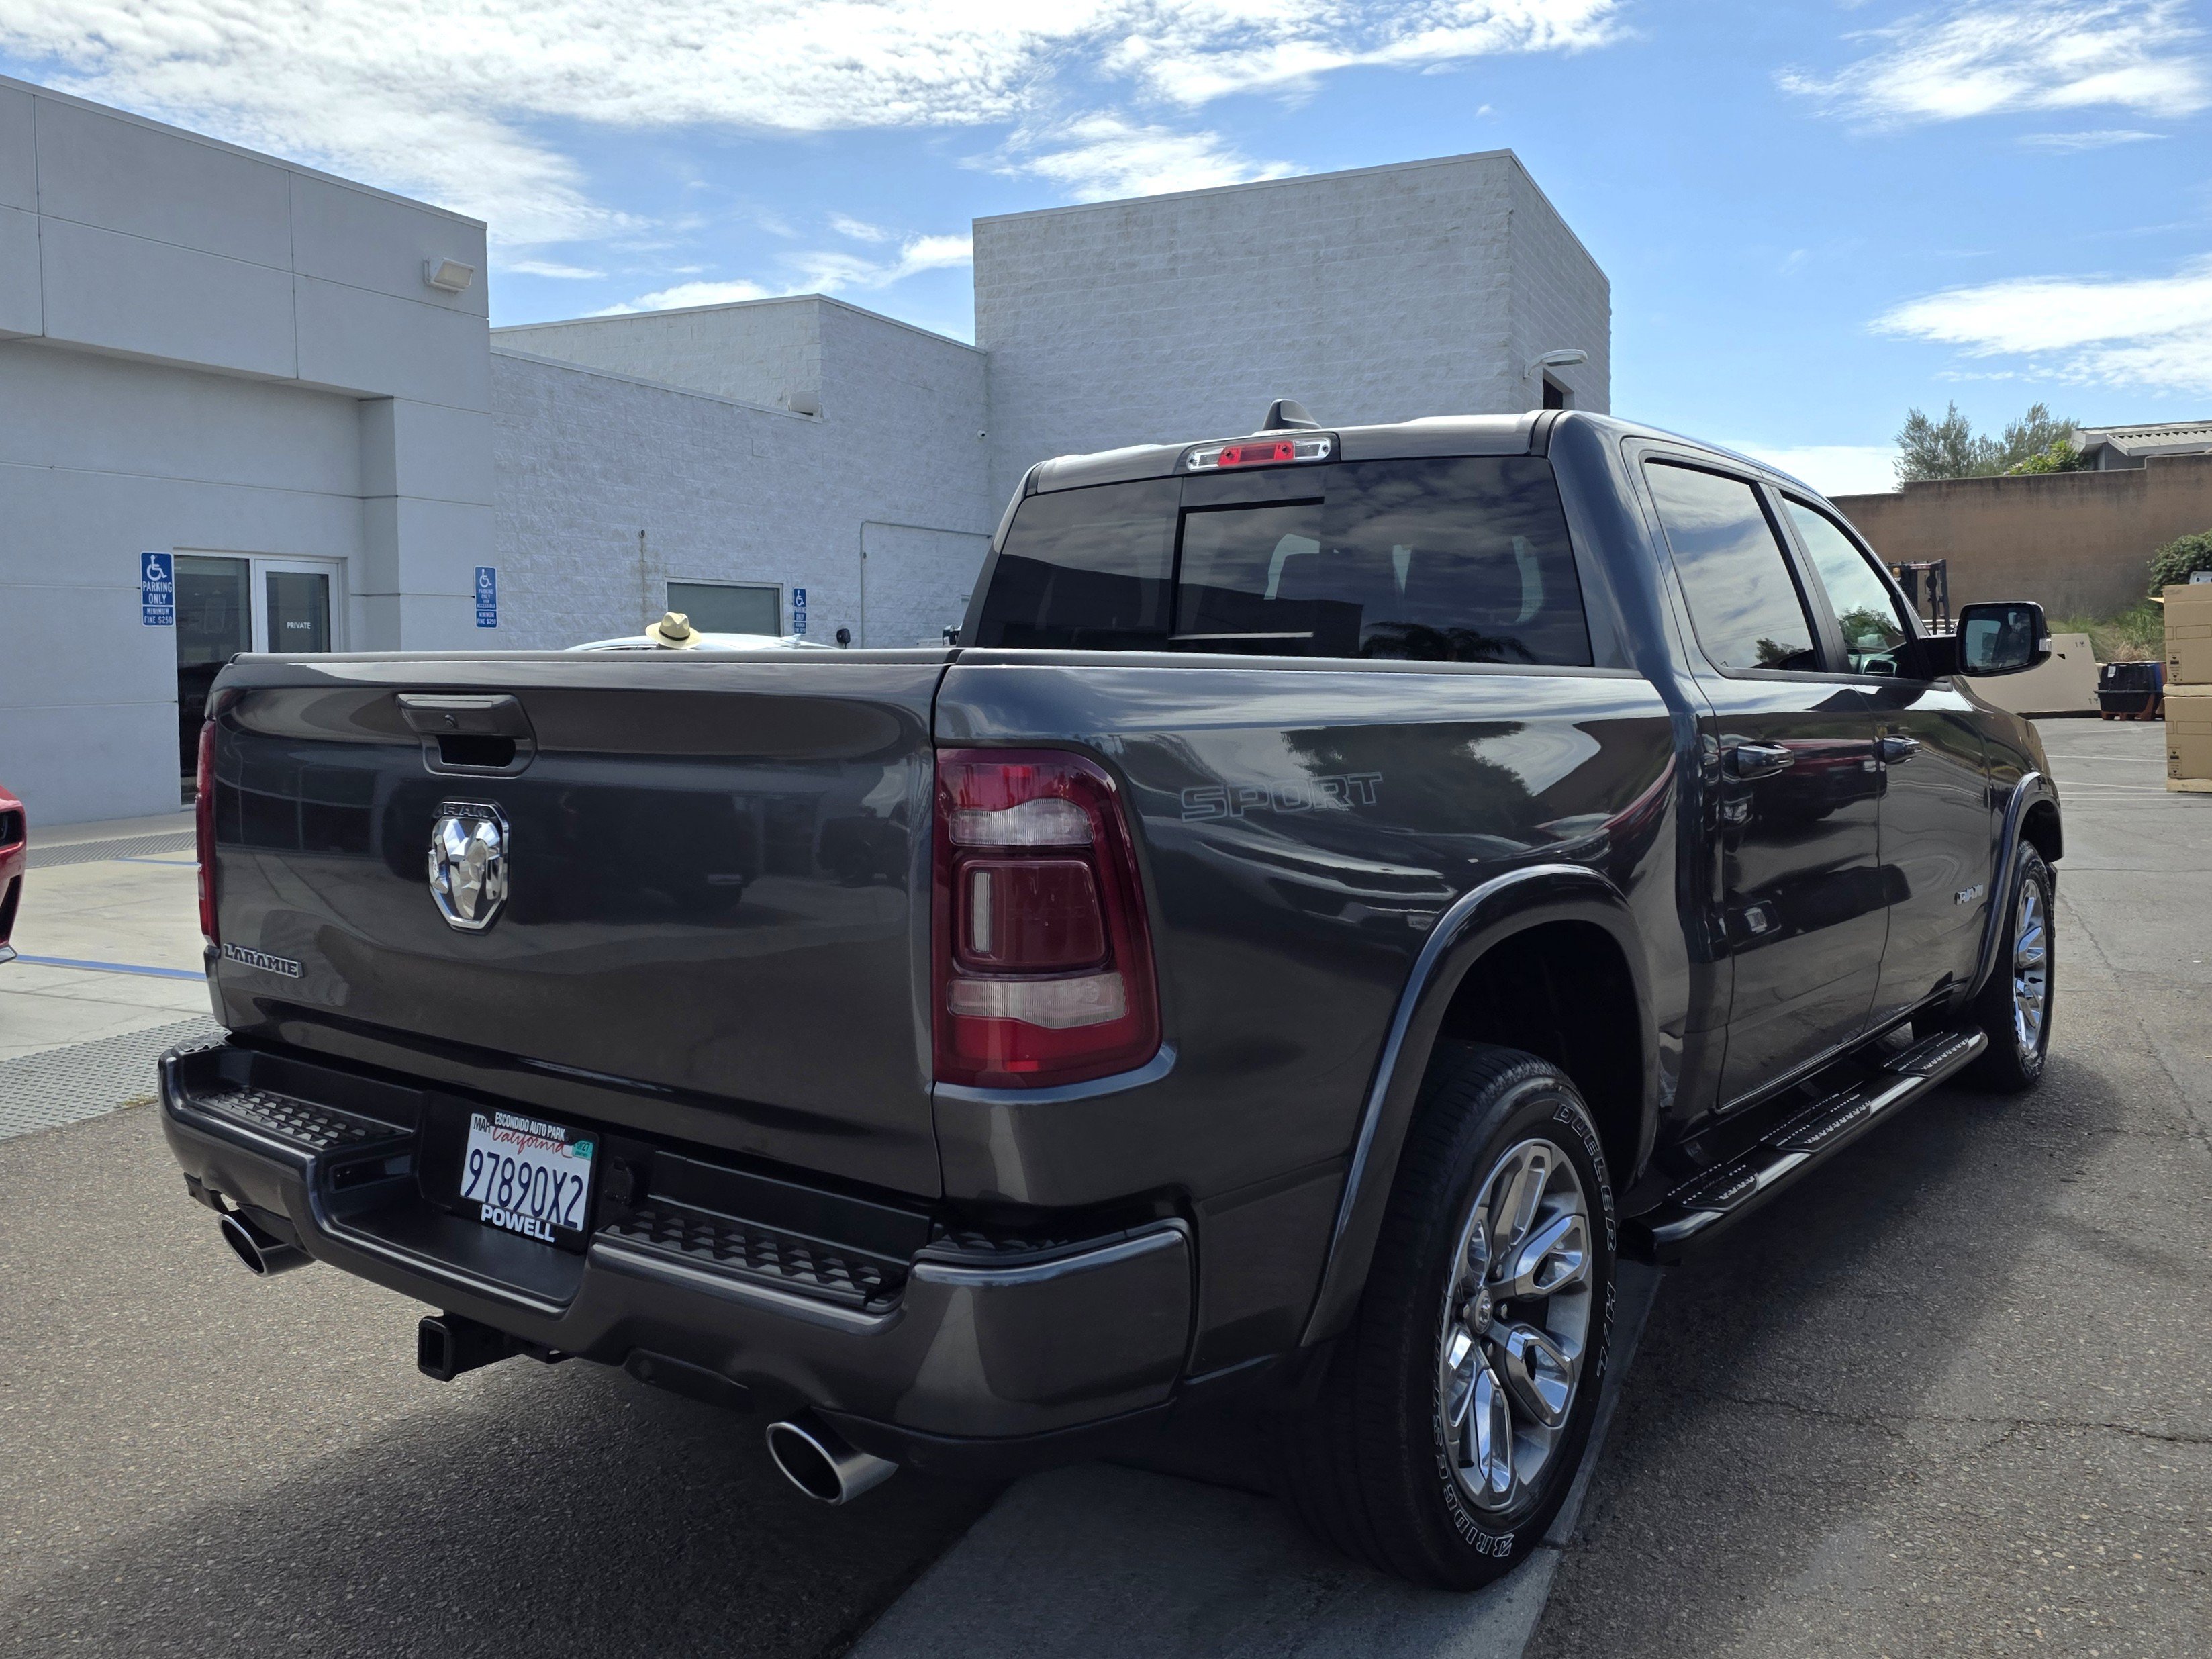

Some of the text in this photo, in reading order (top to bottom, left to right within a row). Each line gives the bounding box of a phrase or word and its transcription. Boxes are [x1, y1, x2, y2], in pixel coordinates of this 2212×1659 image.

[142, 581, 173, 593] PARKING
[148, 593, 167, 604] ONLY
[144, 616, 173, 624] FINE $250
[287, 622, 311, 630] PRIVATE
[442, 804, 489, 818] RAM
[1181, 772, 1382, 822] SPORT
[224, 943, 303, 979] LARAMIE
[495, 1112, 566, 1141] ESCONDIDO AUTO PARK
[492, 1127, 573, 1159] California
[464, 1149, 583, 1229] 97890X2
[1553, 1103, 1617, 1251] DUELER
[480, 1204, 555, 1243] POWELL
[1596, 1280, 1616, 1377] H/L
